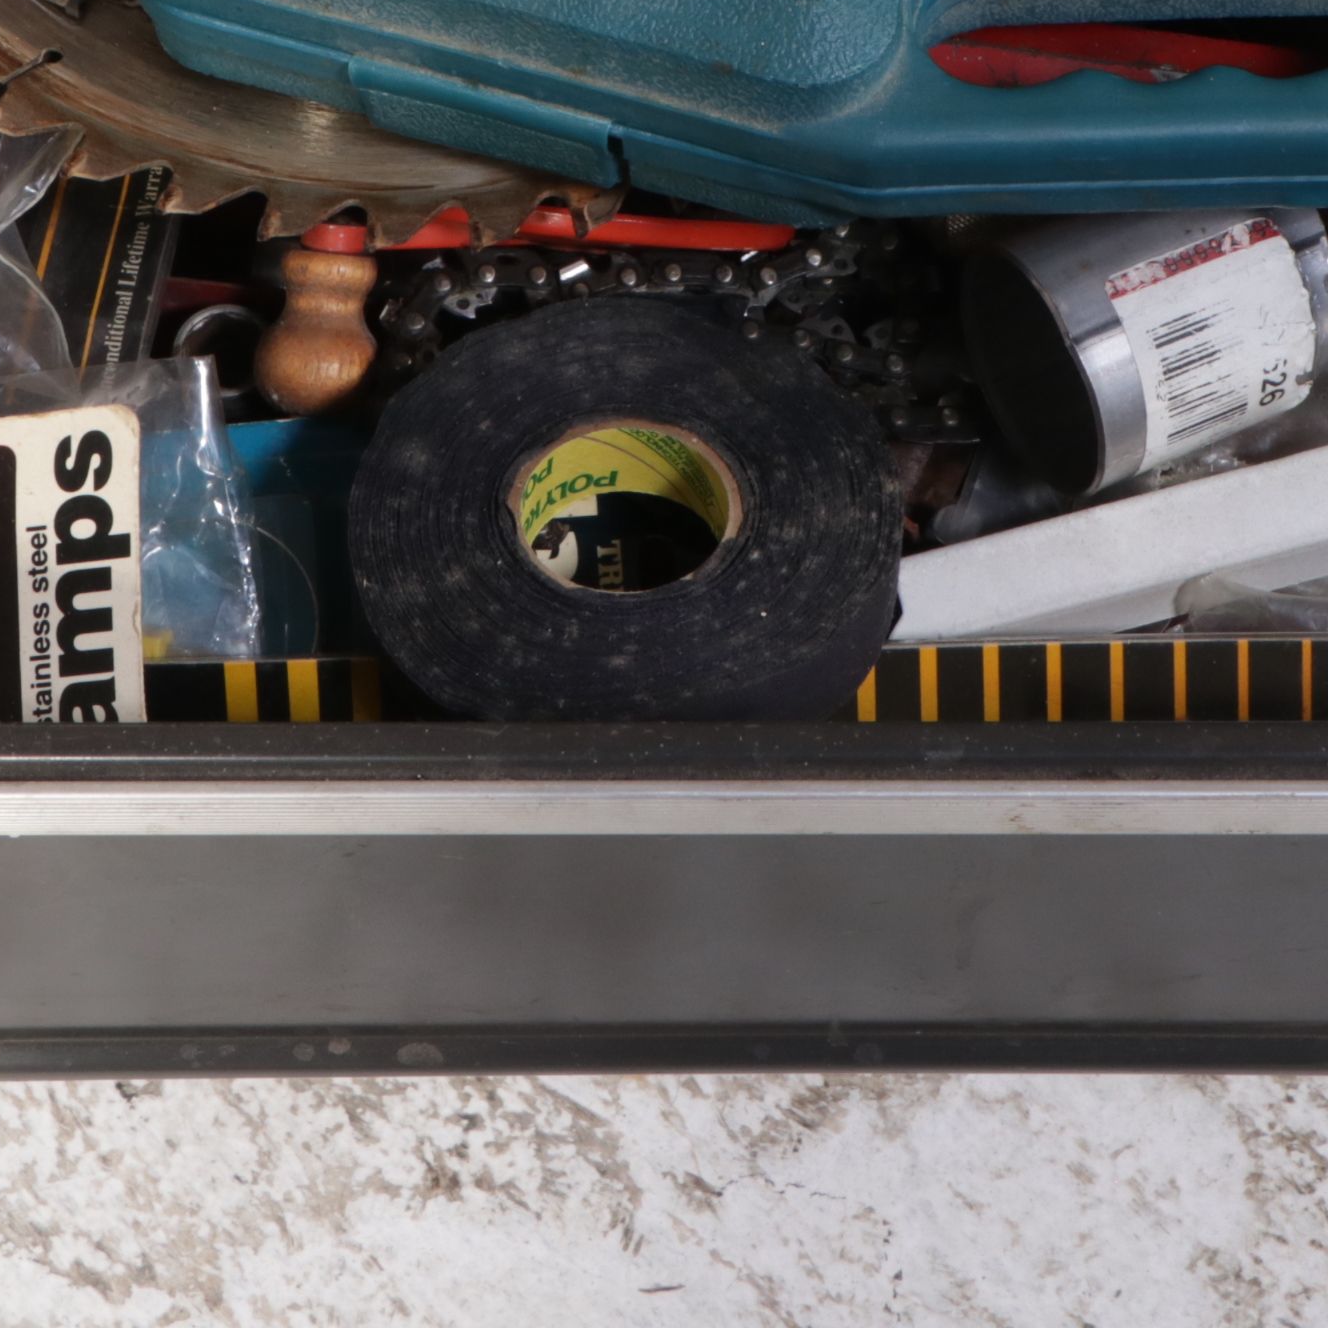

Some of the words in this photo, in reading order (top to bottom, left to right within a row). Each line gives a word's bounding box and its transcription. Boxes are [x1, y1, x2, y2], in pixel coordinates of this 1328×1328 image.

[118, 222, 150, 286] Lifetime
[135, 165, 164, 217] Warra
[25, 525, 50, 593] steel
[53, 430, 131, 723] amps
